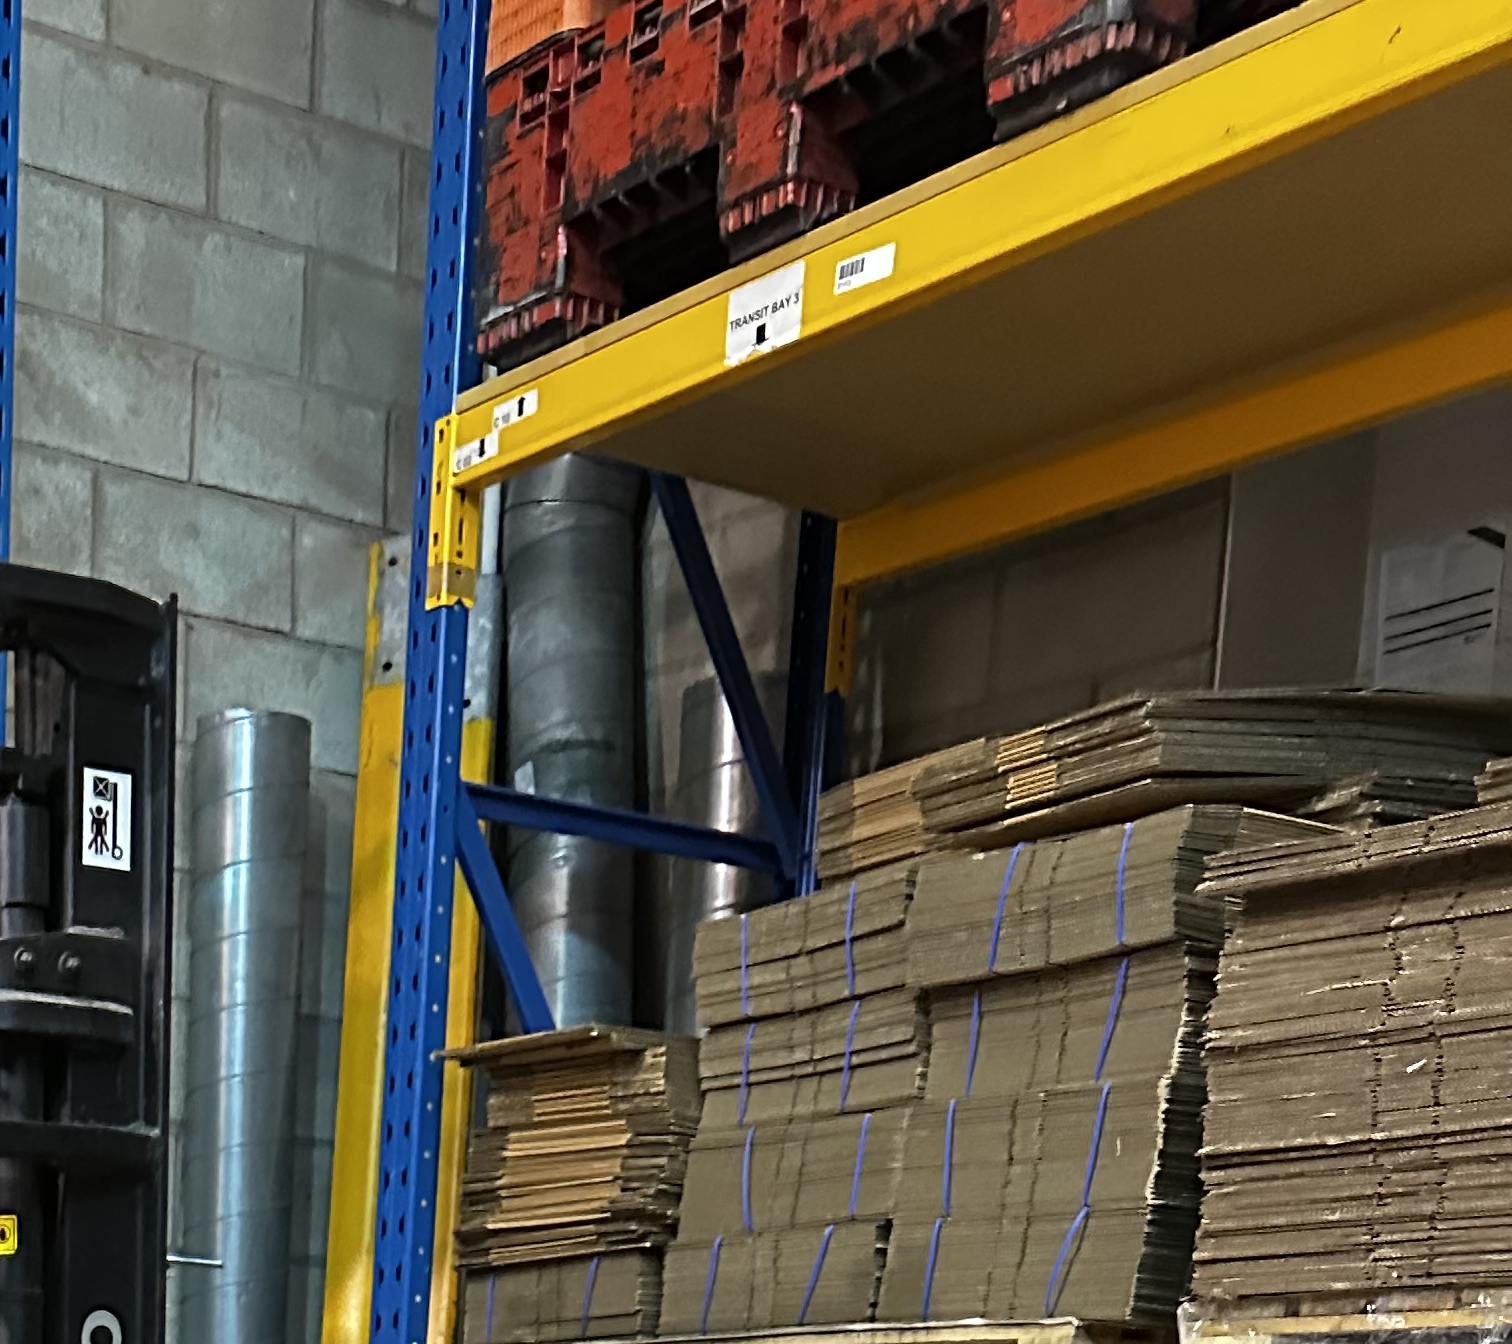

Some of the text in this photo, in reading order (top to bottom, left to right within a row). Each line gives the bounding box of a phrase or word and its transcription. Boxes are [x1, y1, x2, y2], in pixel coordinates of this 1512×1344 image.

[729, 291, 800, 331] TRANSIT BAY 3
